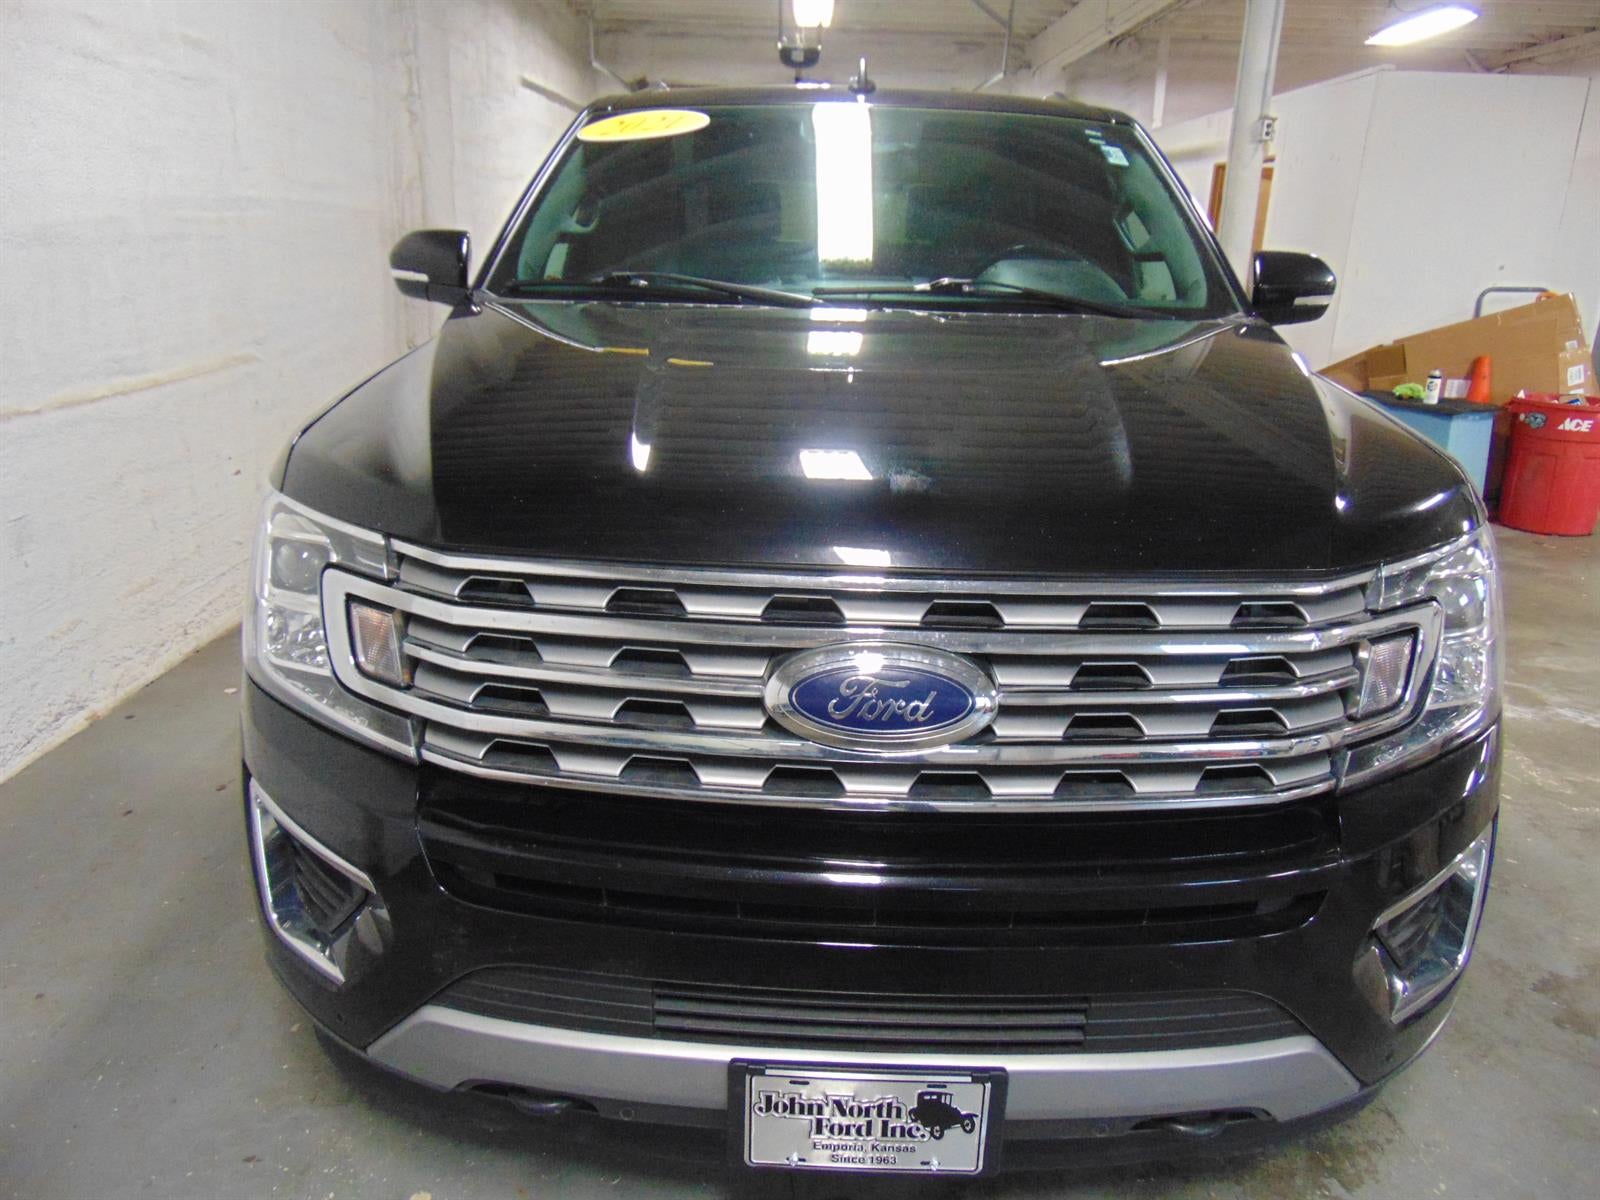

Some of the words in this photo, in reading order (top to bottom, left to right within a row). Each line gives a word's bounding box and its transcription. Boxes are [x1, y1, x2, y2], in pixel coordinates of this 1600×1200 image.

[1558, 418, 1593, 432] ACE
[827, 676, 937, 721] Ford
[754, 1092, 824, 1116] John
[831, 1097, 902, 1119] North
[814, 1118, 873, 1138] Ford
[813, 1141, 867, 1153] Emporia,
[871, 1143, 916, 1153] Kansas
[831, 1154, 866, 1165] Since
[870, 1156, 897, 1165] 1963
